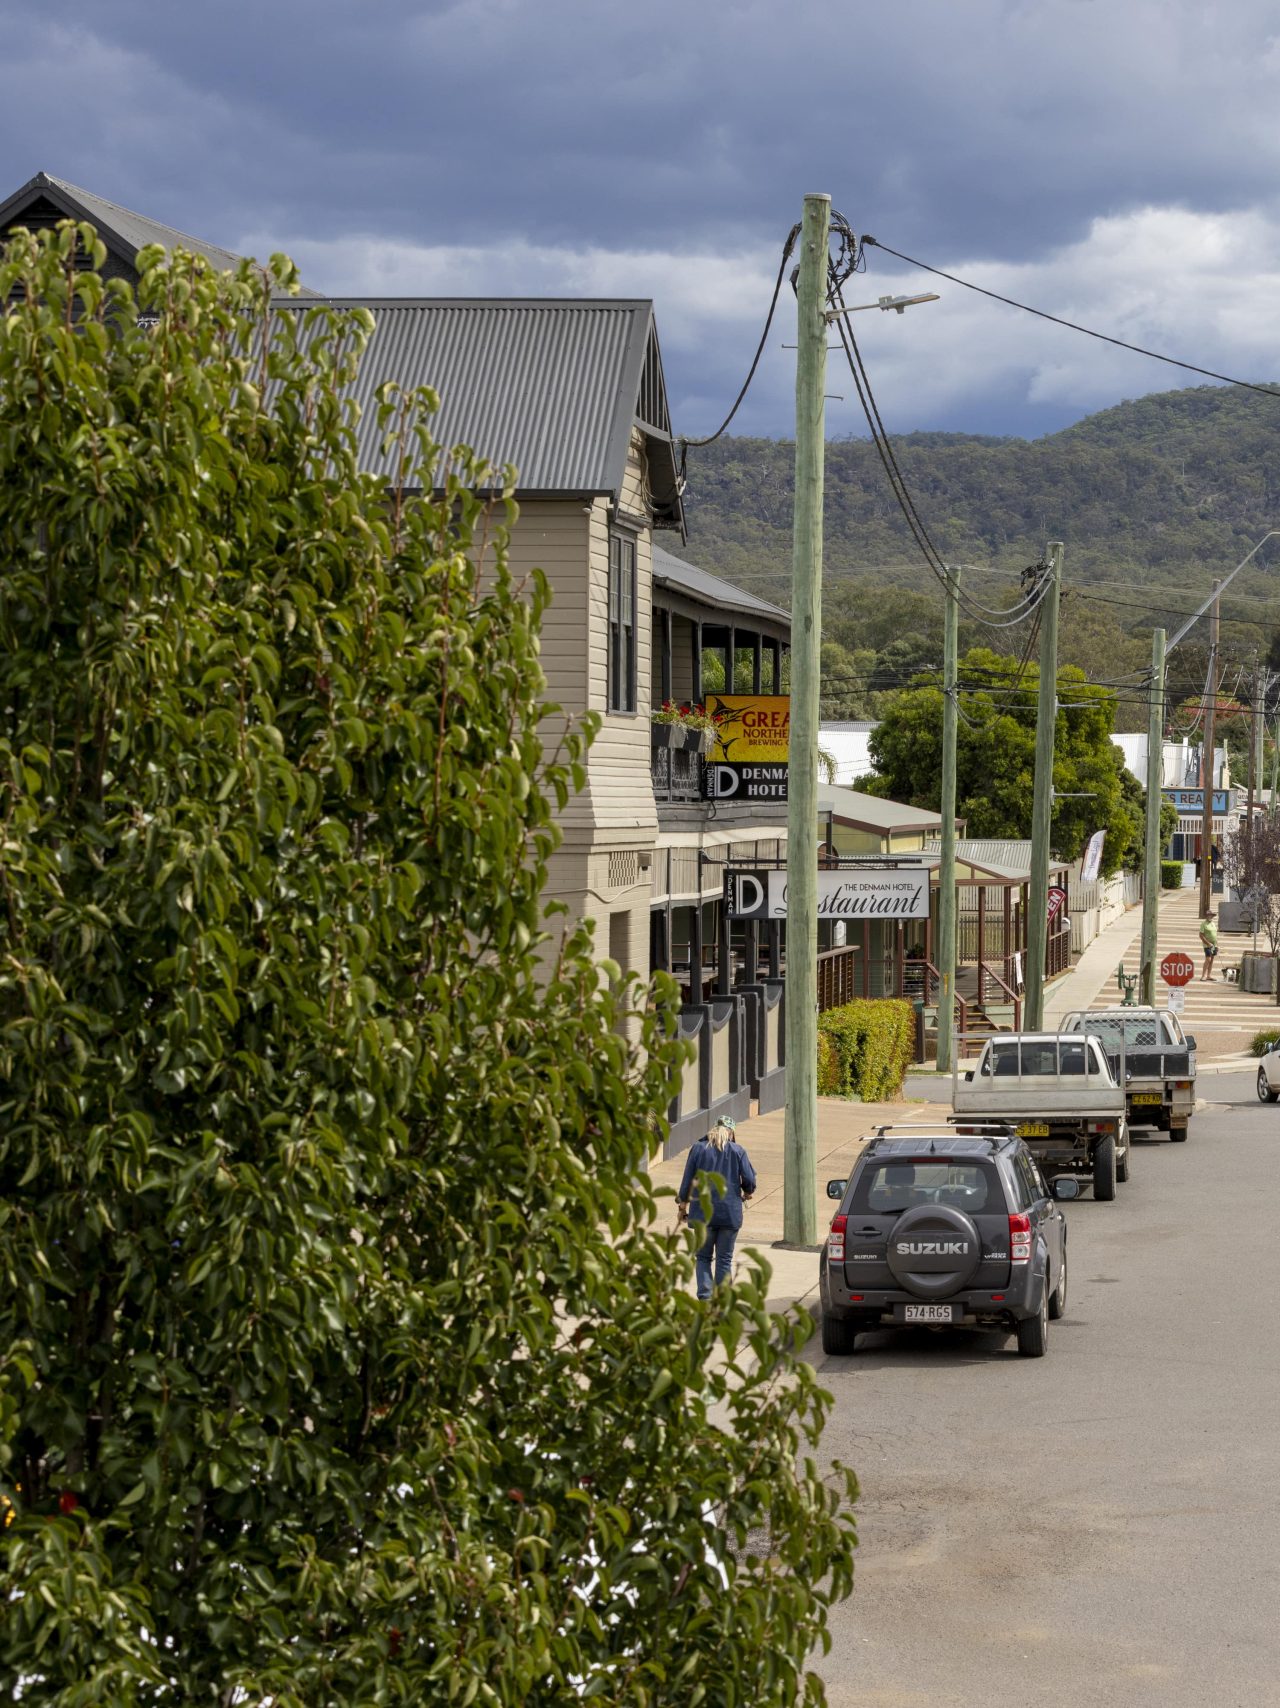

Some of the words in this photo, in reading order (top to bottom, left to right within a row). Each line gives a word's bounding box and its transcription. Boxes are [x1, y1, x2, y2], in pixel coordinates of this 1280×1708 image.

[844, 883, 858, 891] THE
[859, 883, 891, 891] DENMAN
[892, 883, 915, 891] HOTEL
[774, 883, 923, 914] staurant
[1162, 962, 1193, 976] STOP
[896, 1242, 969, 1255] SUZUKI
